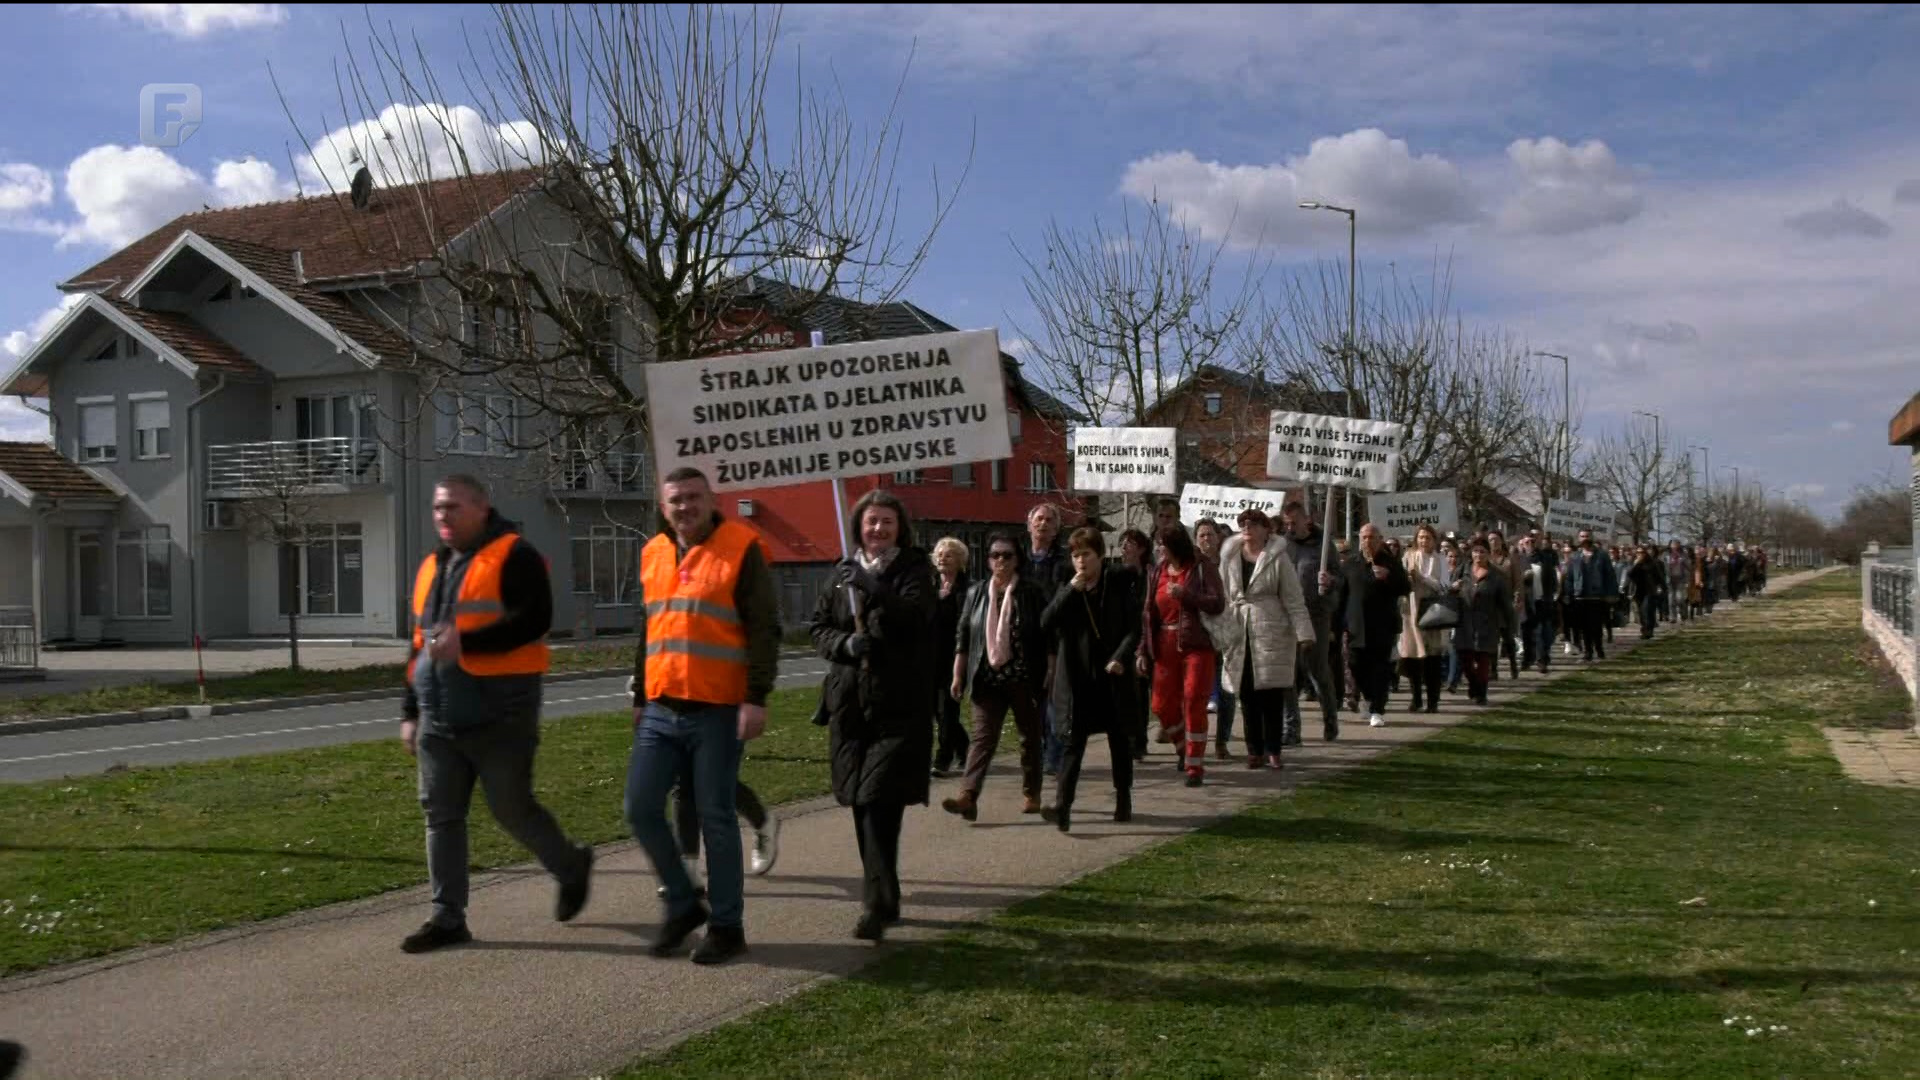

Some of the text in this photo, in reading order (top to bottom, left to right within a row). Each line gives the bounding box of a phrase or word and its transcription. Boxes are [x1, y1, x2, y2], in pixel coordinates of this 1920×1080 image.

[700, 347, 952, 392] ŠTRAJK UPOZORENJA
[693, 376, 965, 424] SINDIKATA DJELATNIKA
[675, 403, 987, 458] ZAPOSLENIH U ZDRAVSTVU
[1275, 424, 1395, 448] DOSTA VIŠE ŠTEDNJE
[716, 437, 957, 484] ŽUPANIJE POSAVSKE
[1077, 445, 1138, 457] KOEFICIJENTE
[1279, 441, 1387, 464] NA ZDRAVSTVENIM
[1086, 462, 1165, 475] A NE SAMO NJIMA
[1296, 461, 1366, 479] RADNICIMA!
[1386, 505, 1398, 514] NE
